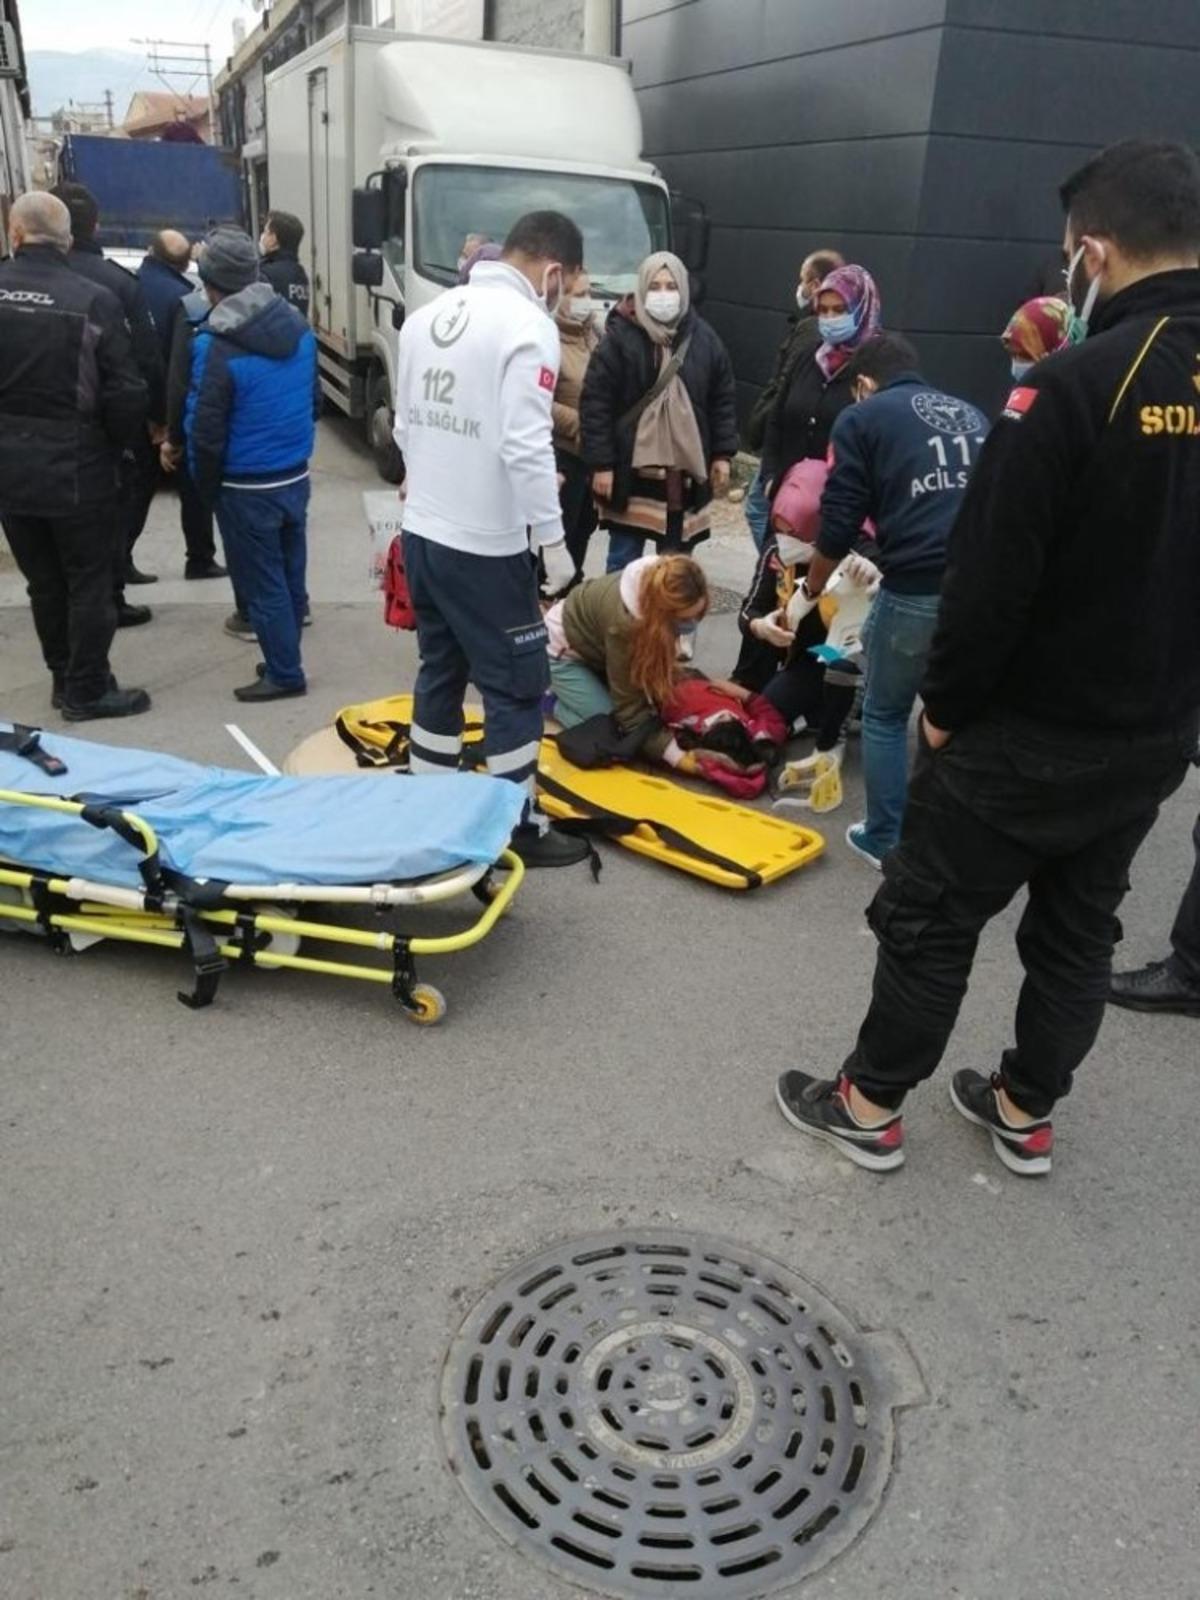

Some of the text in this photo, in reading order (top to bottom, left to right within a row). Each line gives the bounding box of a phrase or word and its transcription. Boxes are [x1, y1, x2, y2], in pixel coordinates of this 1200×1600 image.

[422, 367, 456, 405] 112
[427, 409, 481, 439] SAĞLIK
[928, 434, 985, 466] 11
